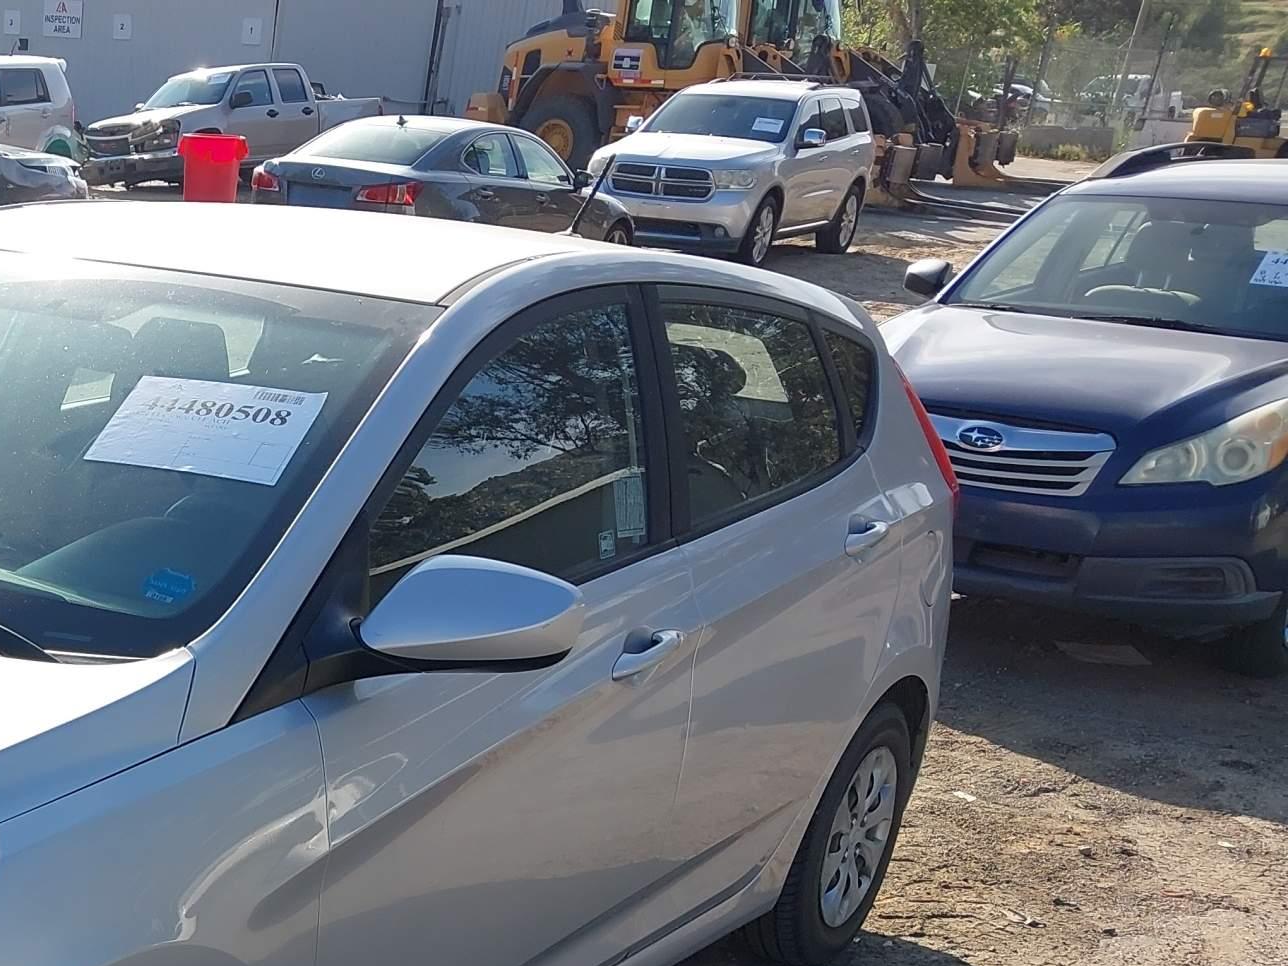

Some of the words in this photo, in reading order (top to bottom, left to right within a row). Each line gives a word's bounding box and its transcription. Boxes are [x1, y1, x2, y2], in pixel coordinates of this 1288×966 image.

[44, 14, 81, 25] INSPECTION
[53, 25, 71, 34] AREA
[143, 396, 292, 427] 44480508
